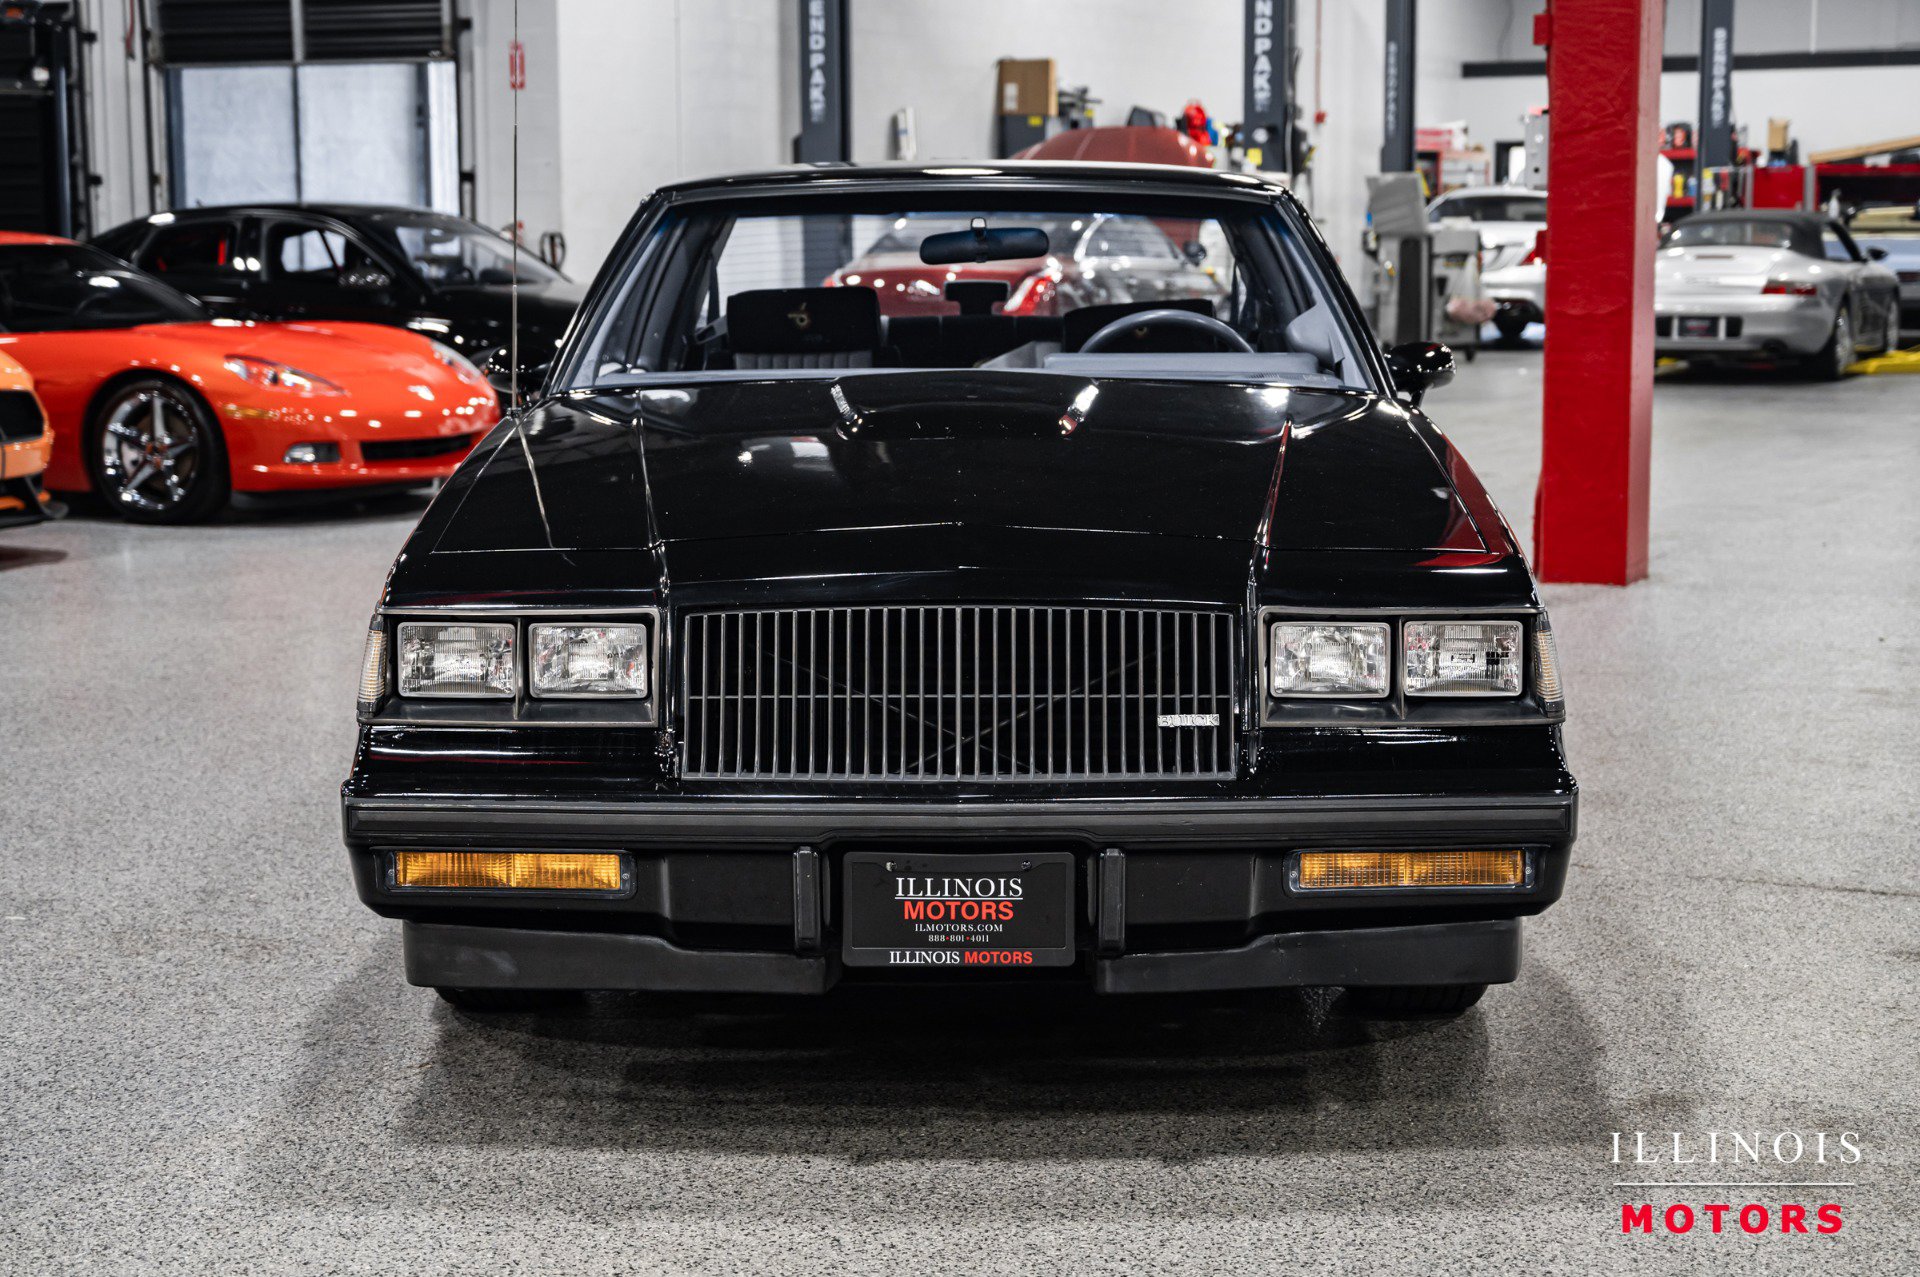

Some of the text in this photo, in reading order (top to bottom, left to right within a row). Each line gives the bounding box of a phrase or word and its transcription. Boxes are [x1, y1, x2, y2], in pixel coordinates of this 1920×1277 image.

[1157, 714, 1220, 728] BUICK
[895, 877, 1023, 898] ILLINOIS
[904, 901, 1014, 921] MOTORS
[914, 923, 1003, 932] ILMOTORS.COM
[889, 951, 1033, 965] ILLINOIS MOTORS
